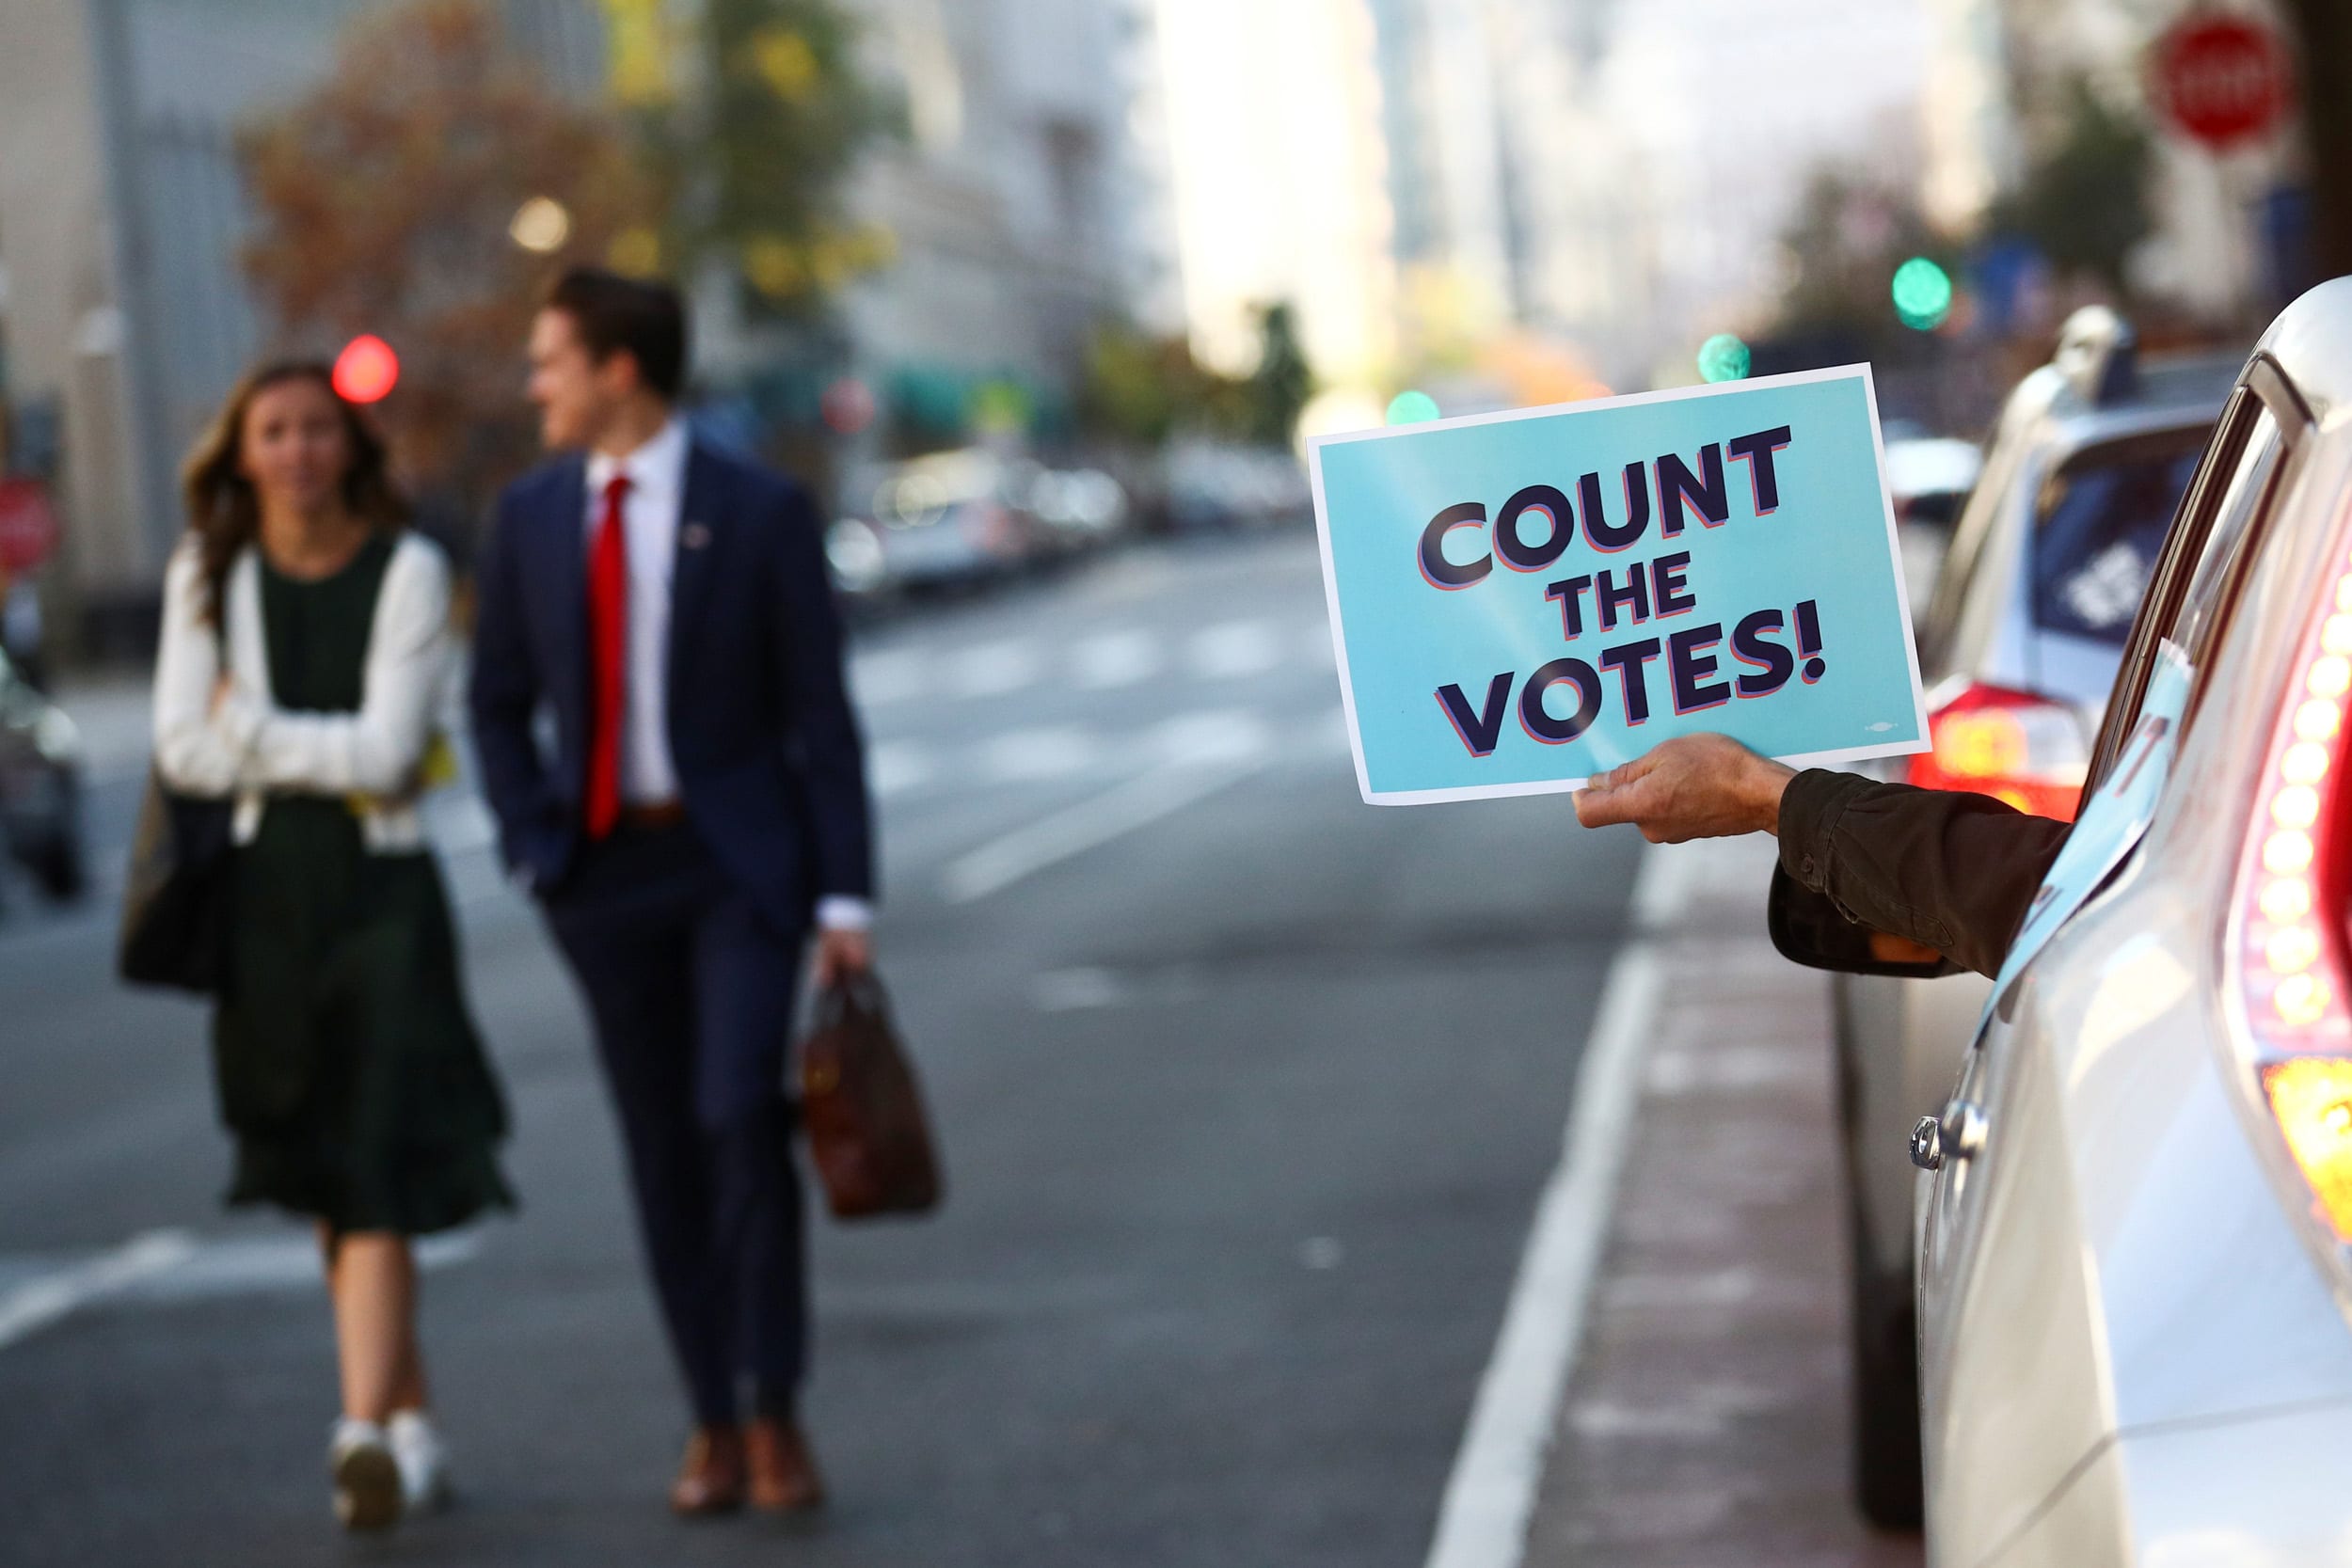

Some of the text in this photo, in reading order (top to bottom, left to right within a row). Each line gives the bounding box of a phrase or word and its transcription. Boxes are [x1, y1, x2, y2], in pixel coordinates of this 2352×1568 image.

[1418, 425, 1791, 590] COUNT
[1545, 550, 1696, 641] THE
[1434, 599, 1826, 757] VOTES!
